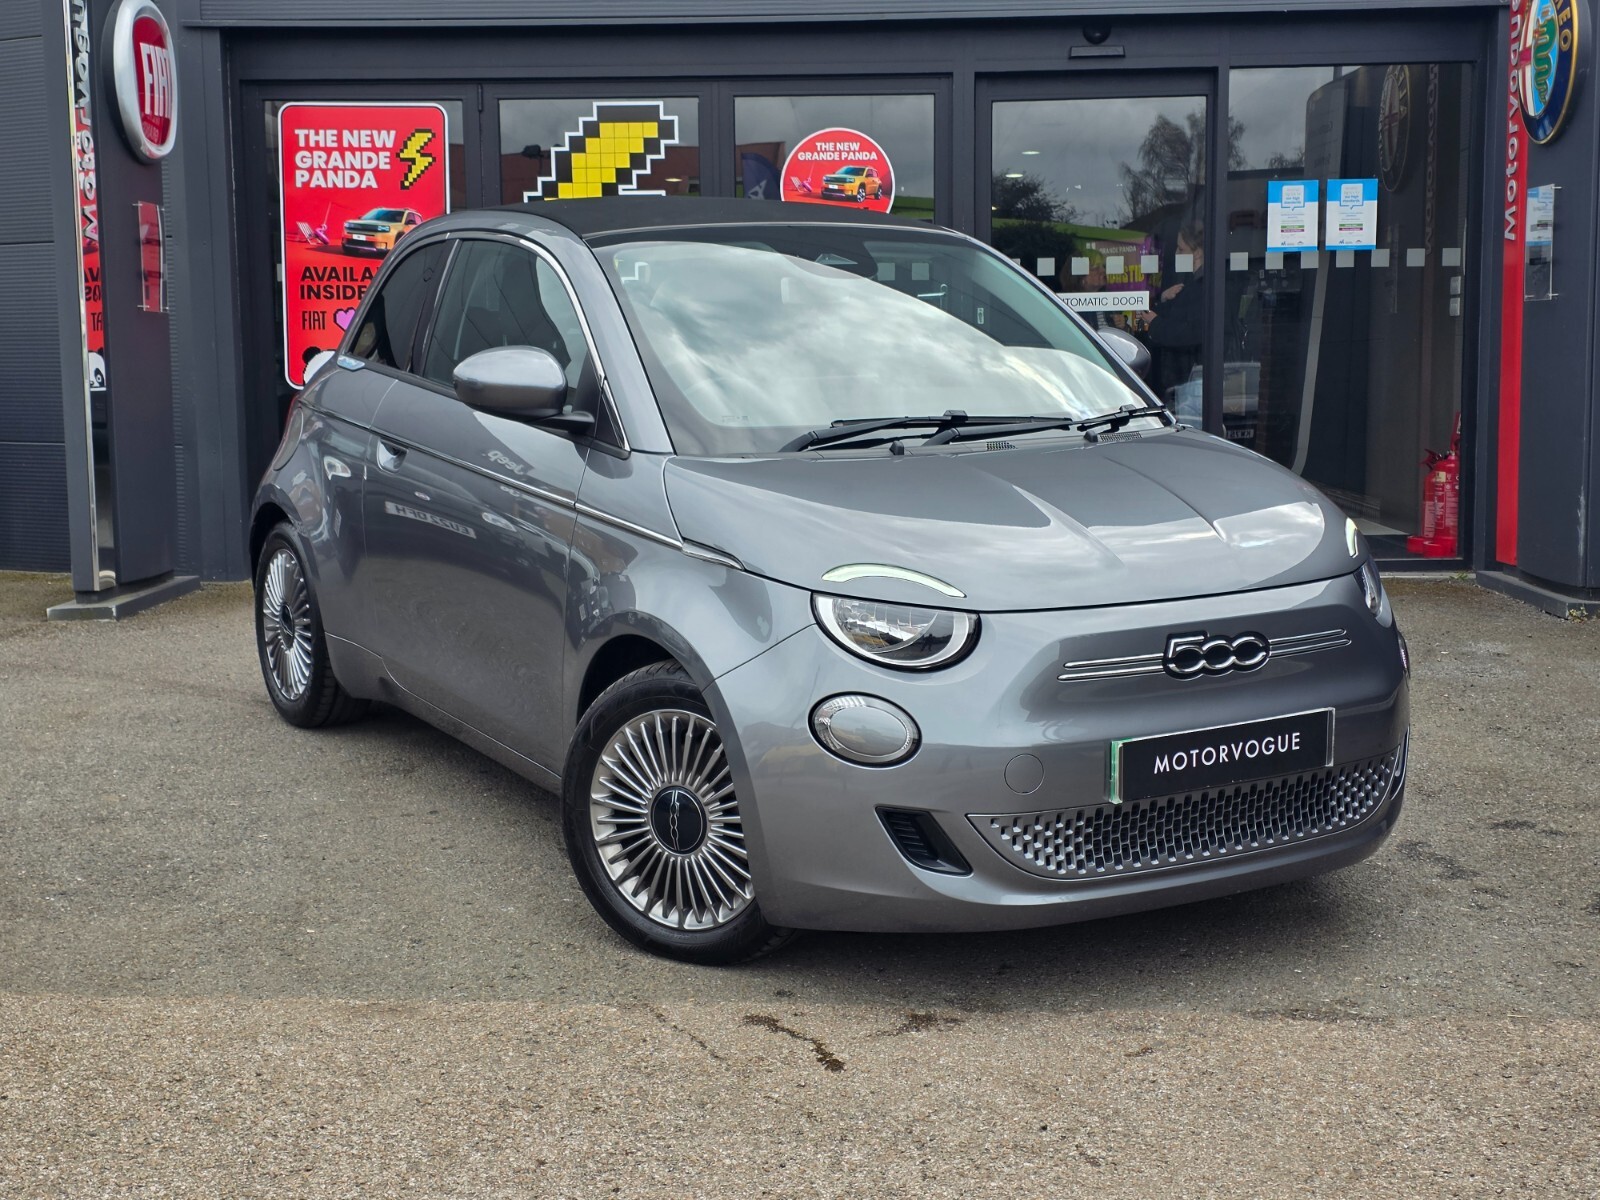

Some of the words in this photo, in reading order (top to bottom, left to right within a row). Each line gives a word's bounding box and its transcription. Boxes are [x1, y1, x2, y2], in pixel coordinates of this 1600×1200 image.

[139, 42, 172, 120] FIAT
[294, 129, 338, 148] THE
[342, 129, 396, 148] NEW
[815, 142, 834, 151] THE
[836, 142, 860, 151] NEW
[295, 150, 391, 170] GRANDE
[797, 151, 840, 161] GRANDE
[841, 151, 878, 161] PANDA
[295, 169, 378, 189] PANDA
[301, 266, 381, 282] AVAILA
[1062, 297, 1109, 307] TOMATIC
[1112, 296, 1144, 306] DOOR
[302, 310, 327, 331] FIAT
[1163, 632, 1270, 678] 500
[1153, 731, 1301, 775] MOTORVOGUE
